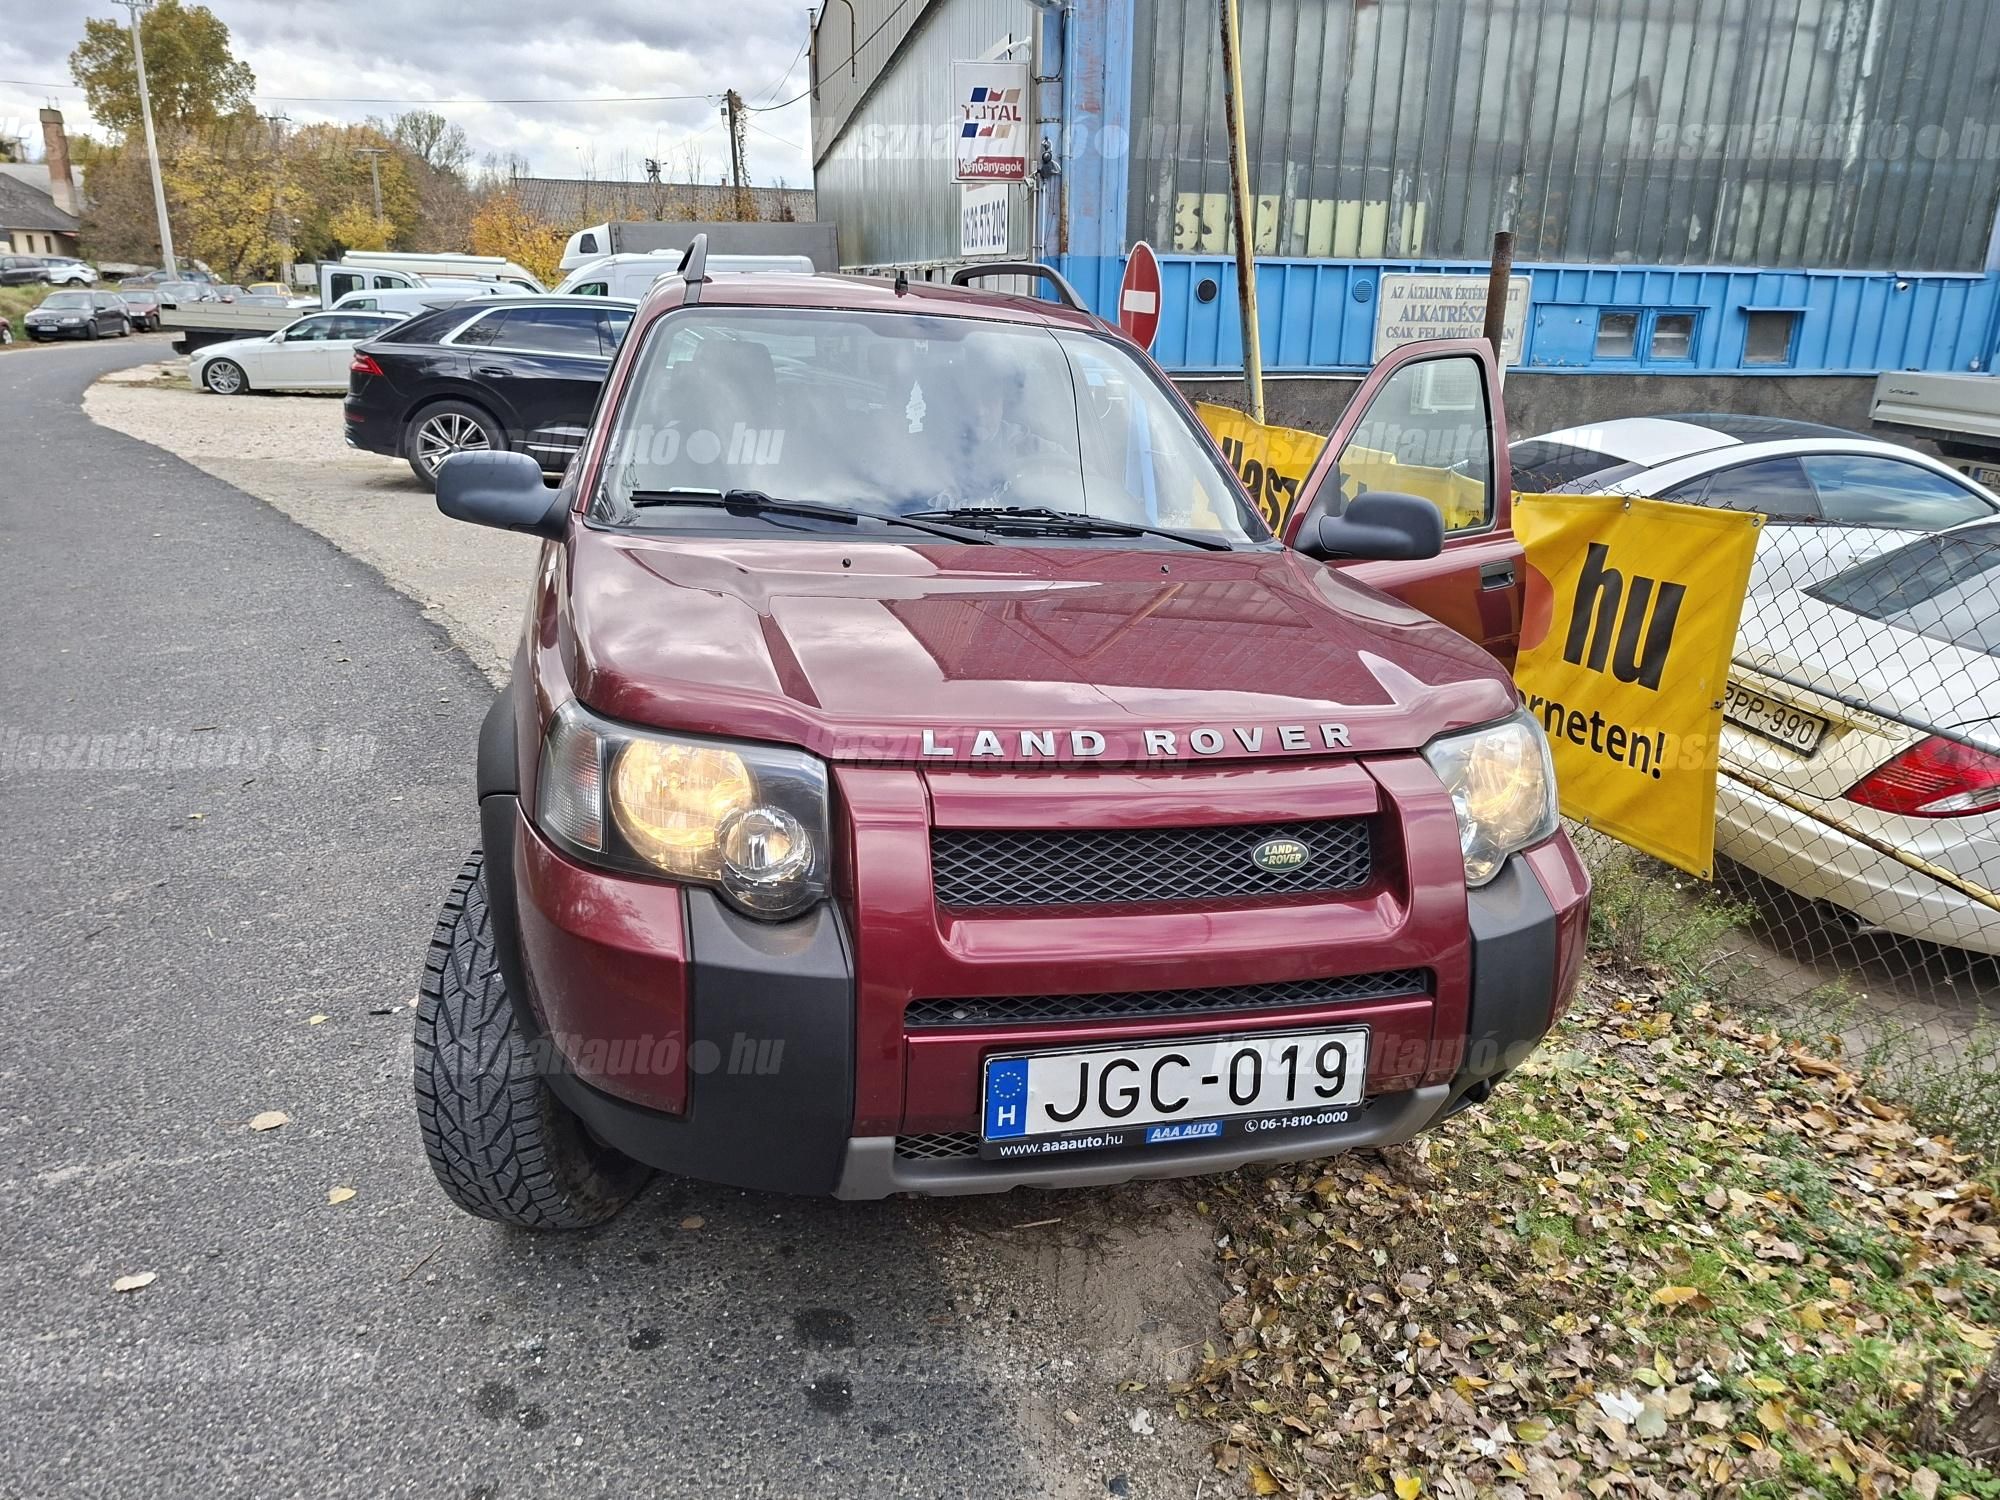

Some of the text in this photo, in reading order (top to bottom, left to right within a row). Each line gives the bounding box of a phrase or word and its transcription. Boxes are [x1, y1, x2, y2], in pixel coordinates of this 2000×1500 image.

[1391, 286, 1405, 299] AZ
[1407, 283, 1454, 300] ÁLTALUNK
[1386, 327, 1414, 339] CSAK
[1563, 542, 1687, 691] hu
[922, 723, 1353, 757] LAND ROVER
[1265, 844, 1302, 864] LAND ROVER
[1044, 1040, 1347, 1123] JGC-019
[997, 1106, 1016, 1127] H
[1000, 1111, 1348, 1156] www.aaaauto.hu AAA AUTO 06-1-810-0000
